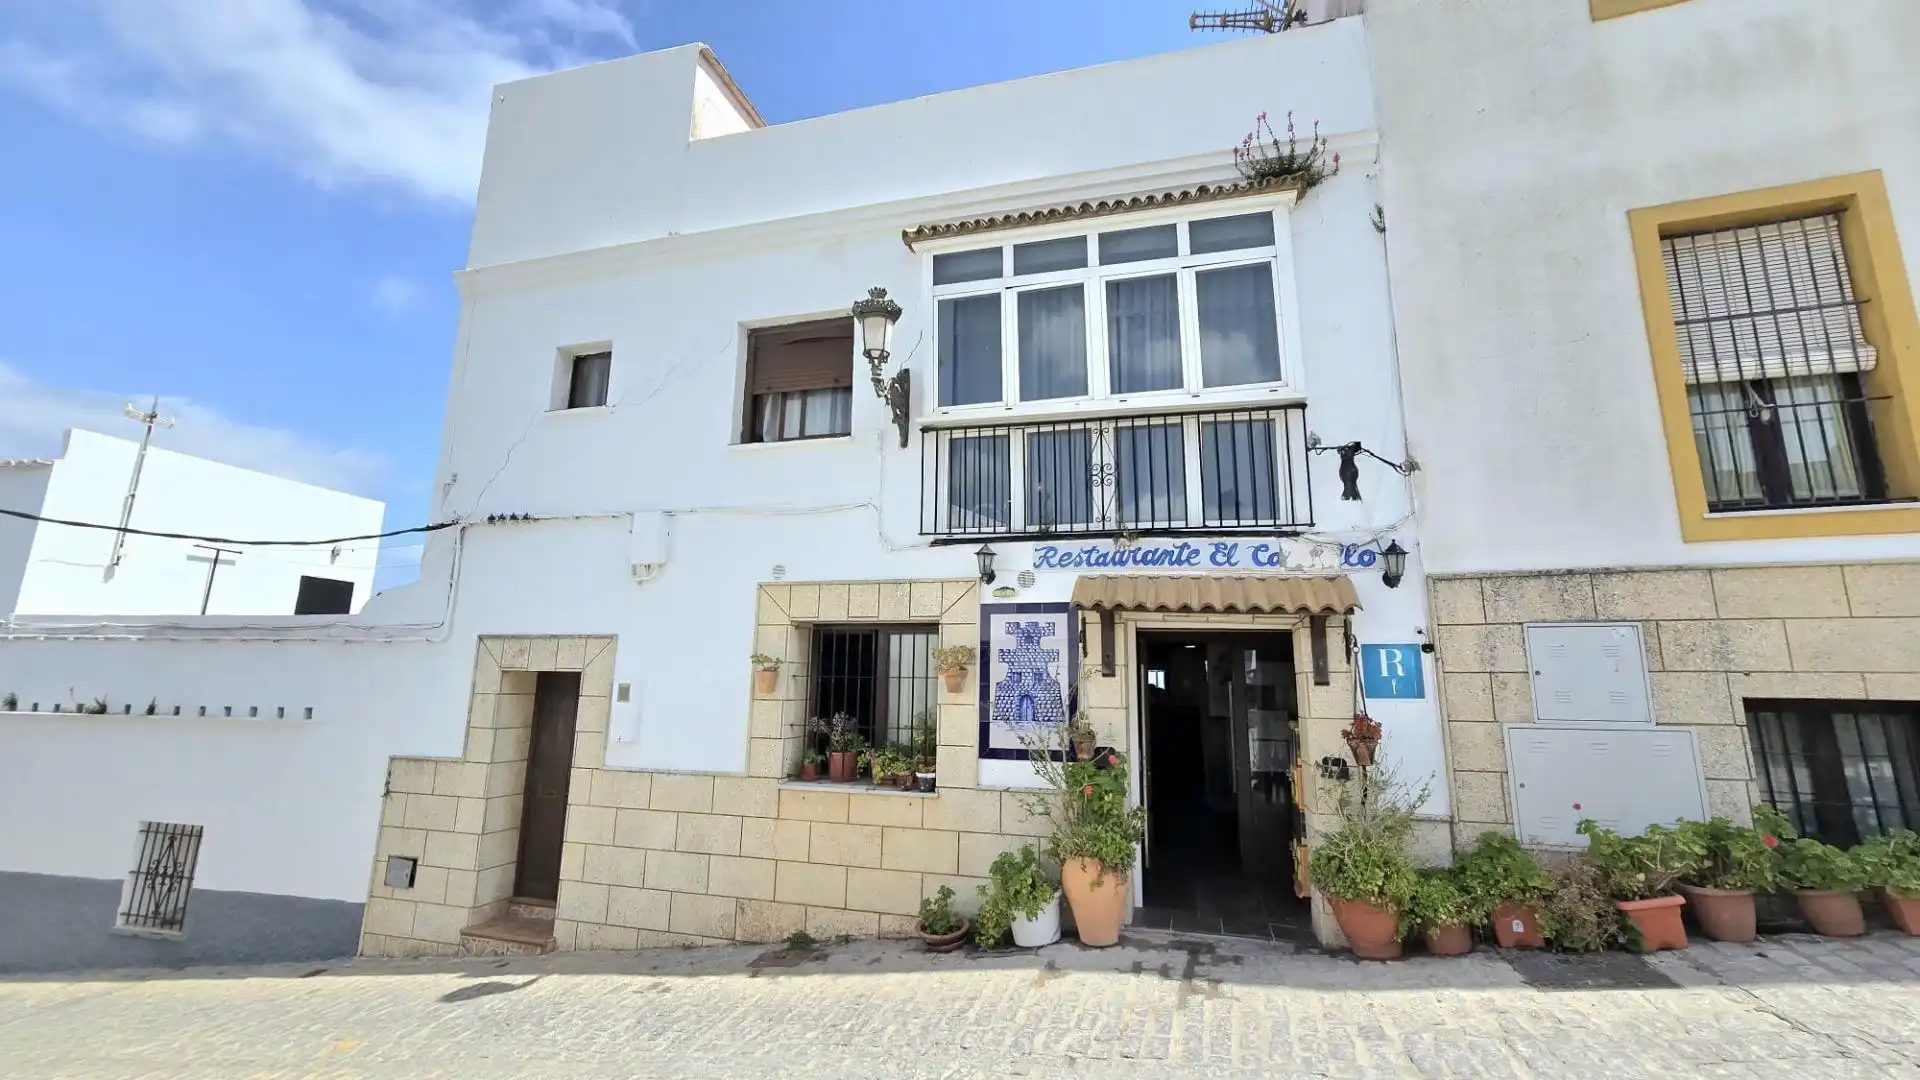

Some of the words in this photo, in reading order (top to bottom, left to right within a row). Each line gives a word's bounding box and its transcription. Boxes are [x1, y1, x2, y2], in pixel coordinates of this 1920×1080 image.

[1033, 541, 1201, 569] Restaurante
[1208, 542, 1240, 567] El
[1376, 648, 1406, 677] R
